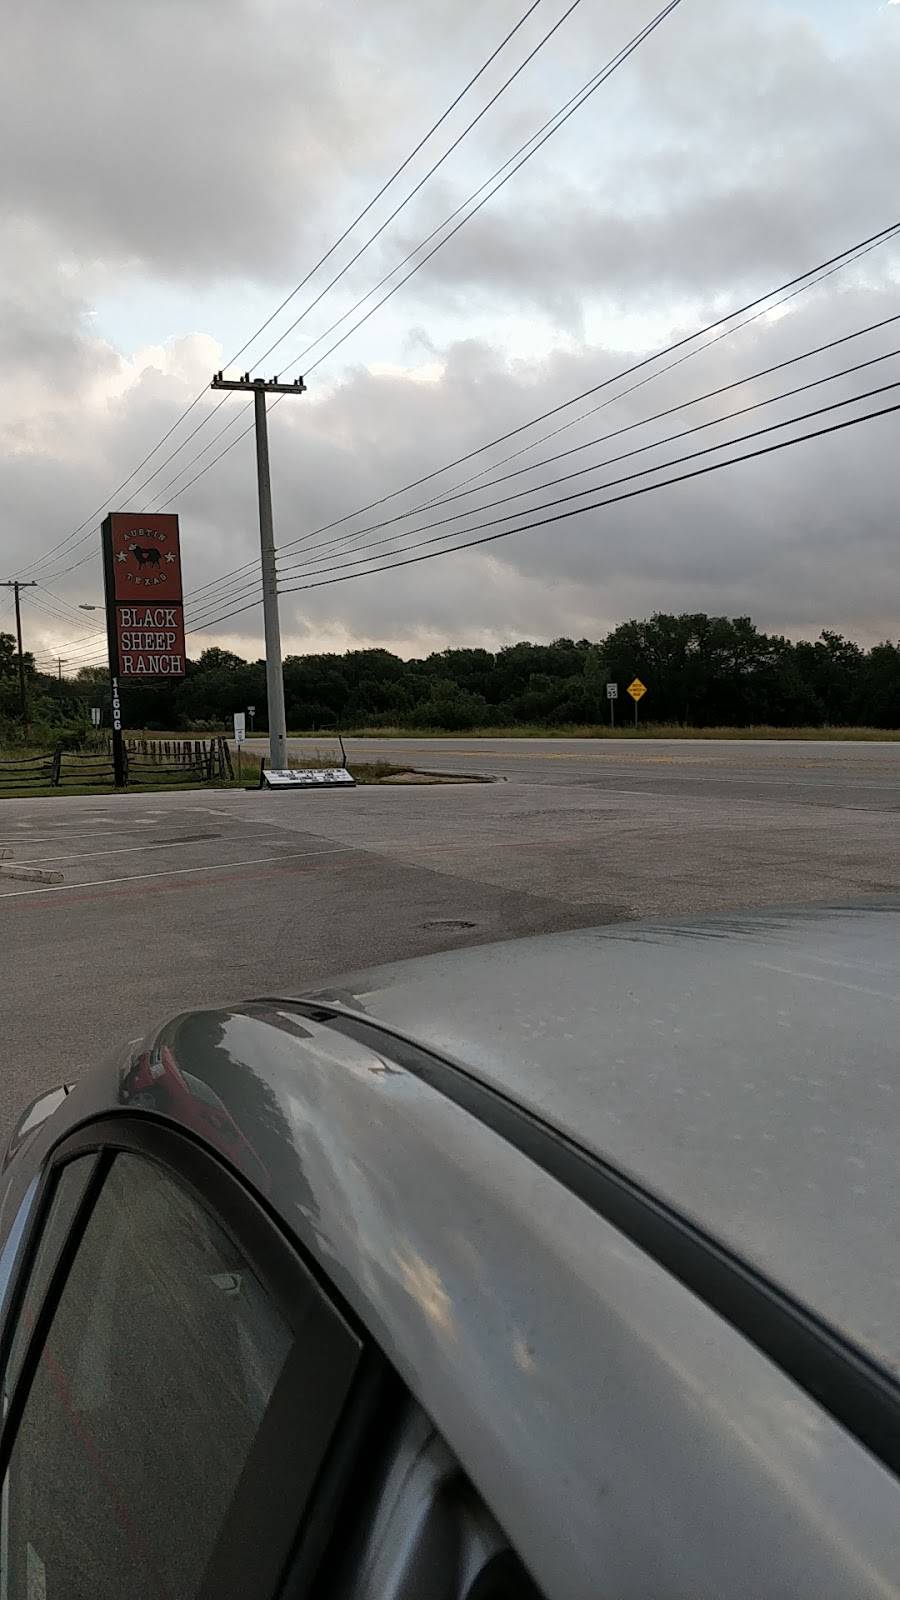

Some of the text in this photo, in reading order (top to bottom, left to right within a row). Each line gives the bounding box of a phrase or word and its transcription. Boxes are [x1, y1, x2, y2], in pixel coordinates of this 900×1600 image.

[124, 528, 166, 541] AUSTIN
[127, 573, 167, 585] TEXAS
[120, 608, 178, 628] BLACK
[121, 632, 176, 651] SHEEP
[122, 655, 182, 674] RANCH
[112, 677, 121, 730] 11606
